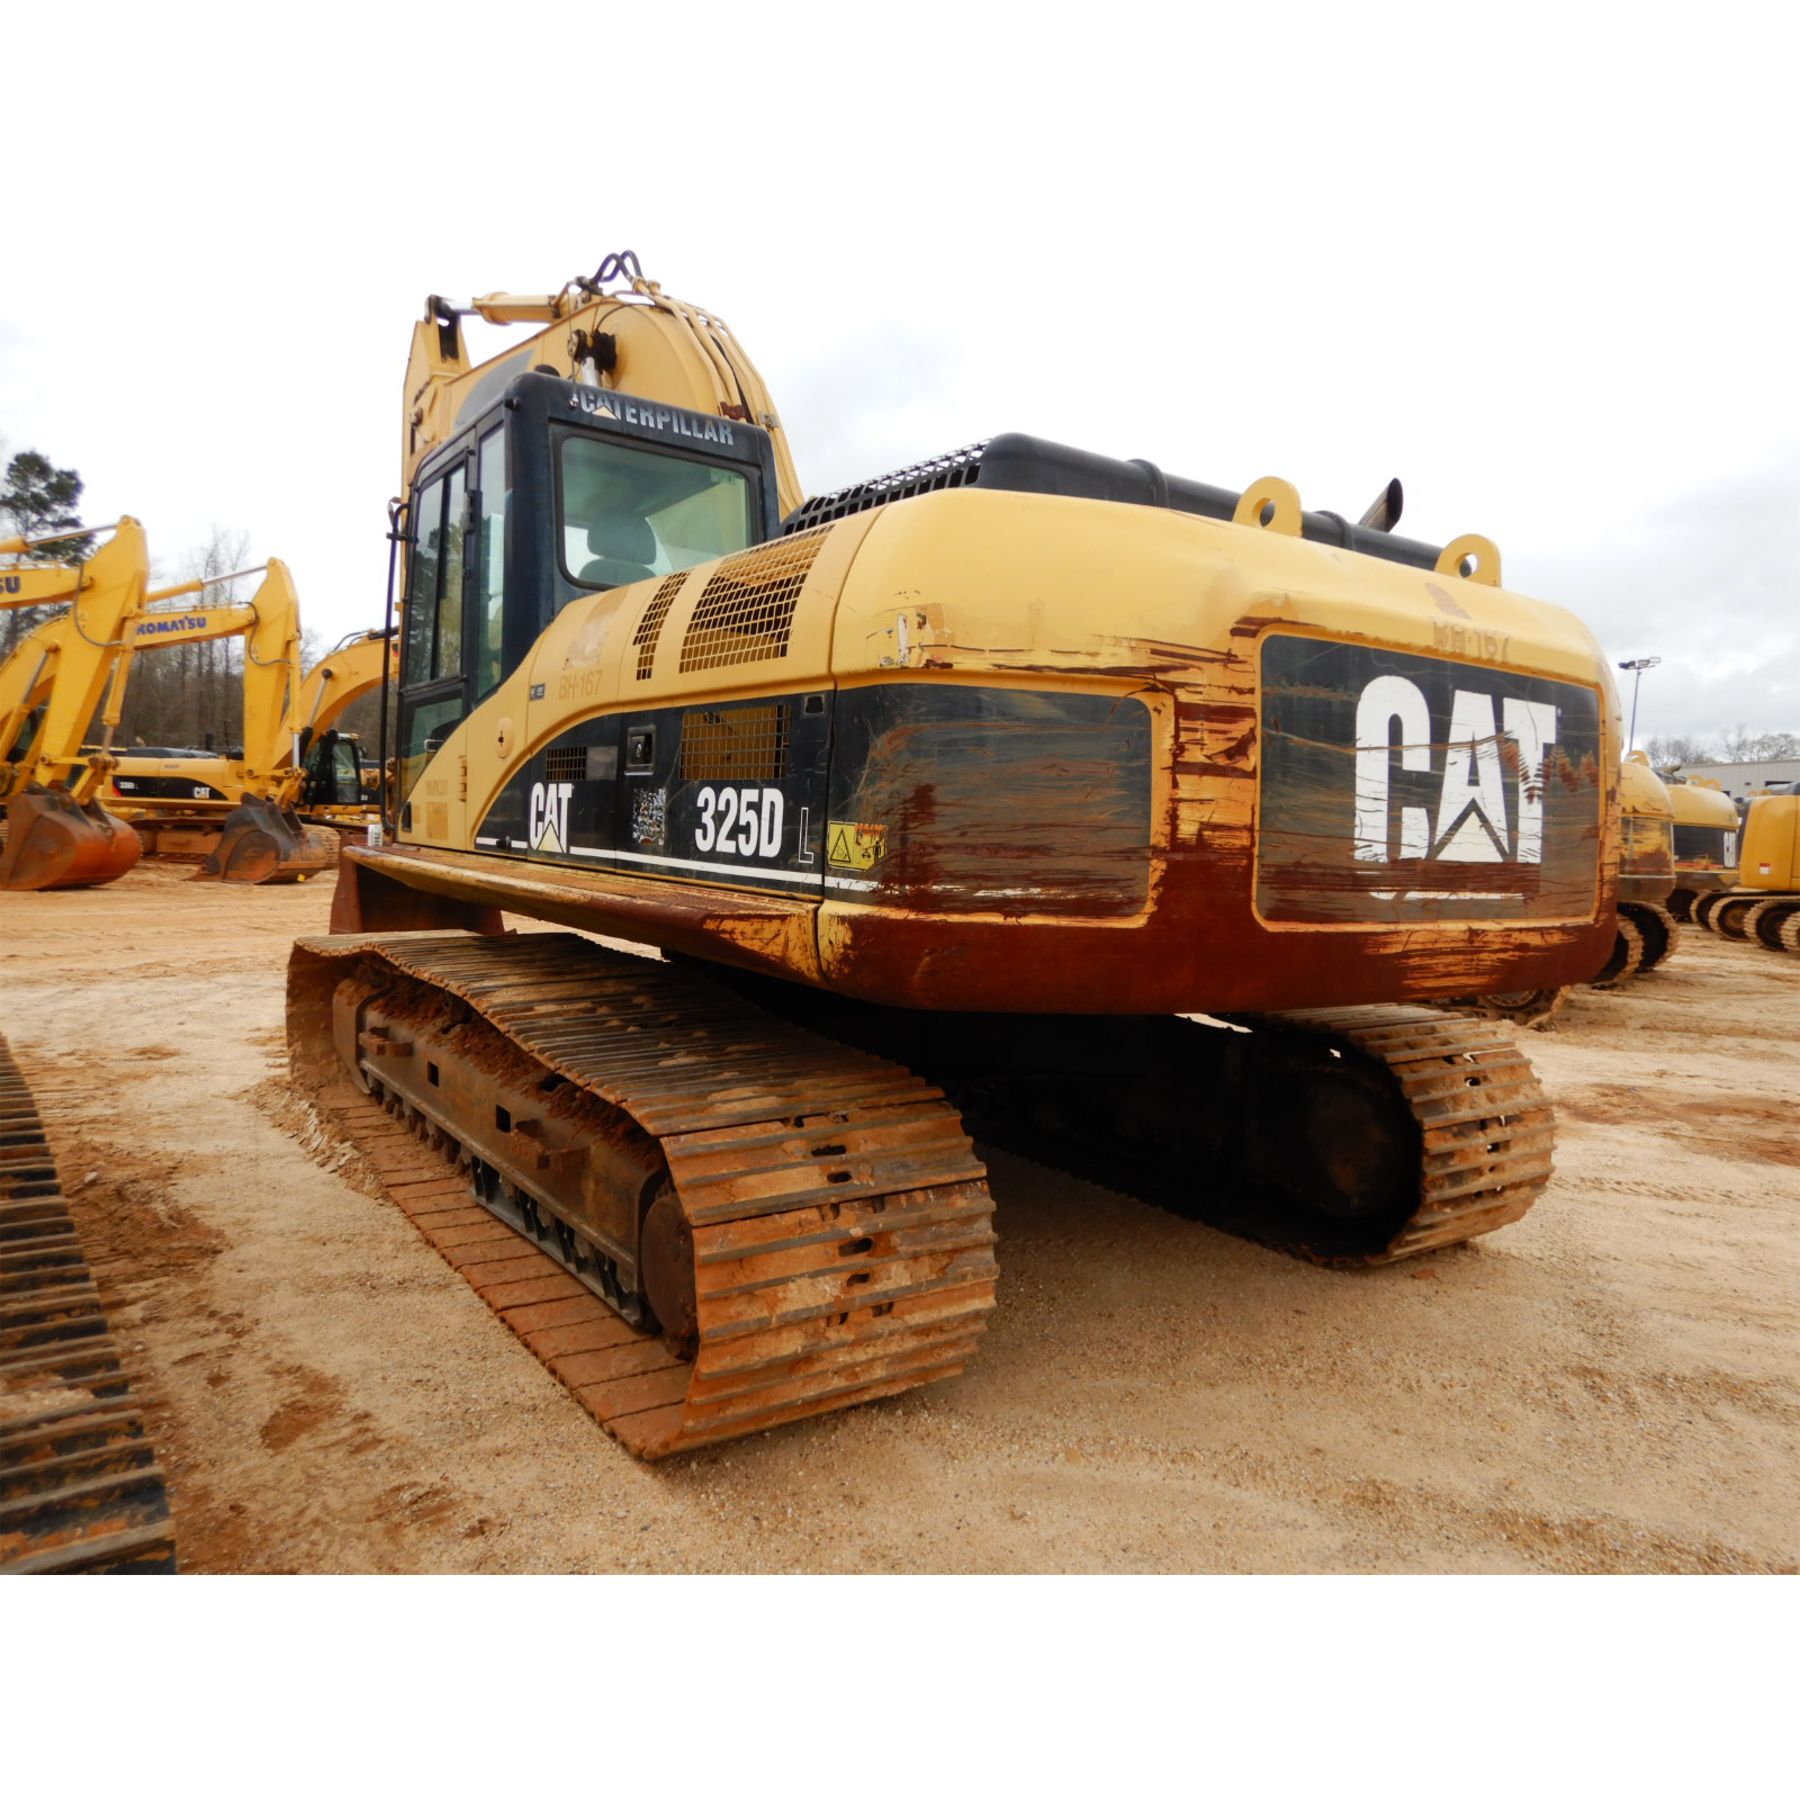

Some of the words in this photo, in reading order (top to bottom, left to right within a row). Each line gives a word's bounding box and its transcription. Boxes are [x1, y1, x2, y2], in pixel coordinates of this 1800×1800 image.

[580, 390, 734, 446] CATERPILLAR
[136, 616, 207, 636] KOMATSU
[193, 786, 211, 800] CAT
[529, 781, 573, 854] CAT
[1354, 674, 1557, 900] CAT
[694, 786, 784, 858] 325D
[798, 806, 815, 864] L
